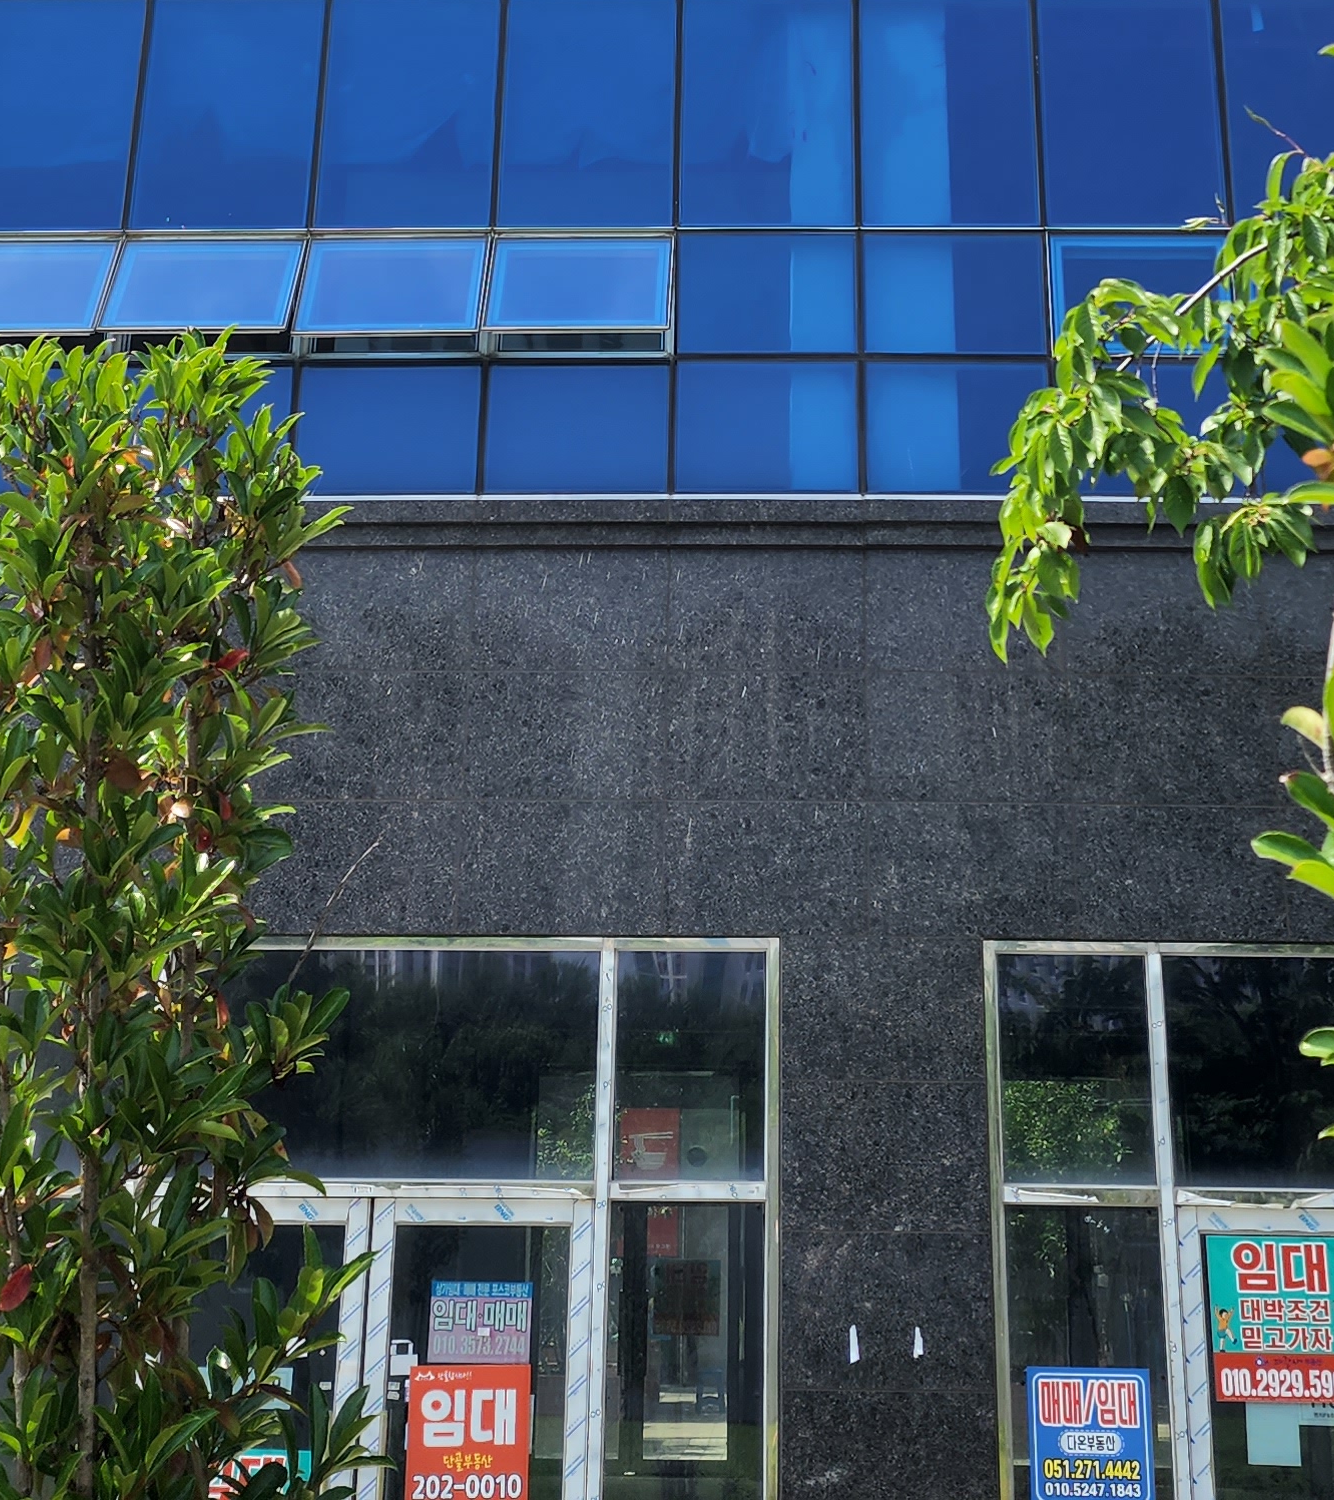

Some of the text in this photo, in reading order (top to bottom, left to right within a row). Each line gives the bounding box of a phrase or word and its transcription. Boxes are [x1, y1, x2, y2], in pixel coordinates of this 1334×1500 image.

[1231, 1241, 1330, 1294] 임대
[1239, 1297, 1331, 1323] 대박조건
[433, 1335, 525, 1355] 010.3573.2744
[1241, 1326, 1333, 1351] 믿고가자
[1038, 1379, 1140, 1428] 매매/임대
[421, 1389, 517, 1448] 임대
[1066, 1435, 1115, 1451] 다온부동산
[443, 1453, 493, 1472] 단골부동산
[1044, 1459, 1141, 1480] 051.271.4442
[412, 1474, 522, 1500] 202-0010
[1045, 1482, 1142, 1498] 010.5247.1843
